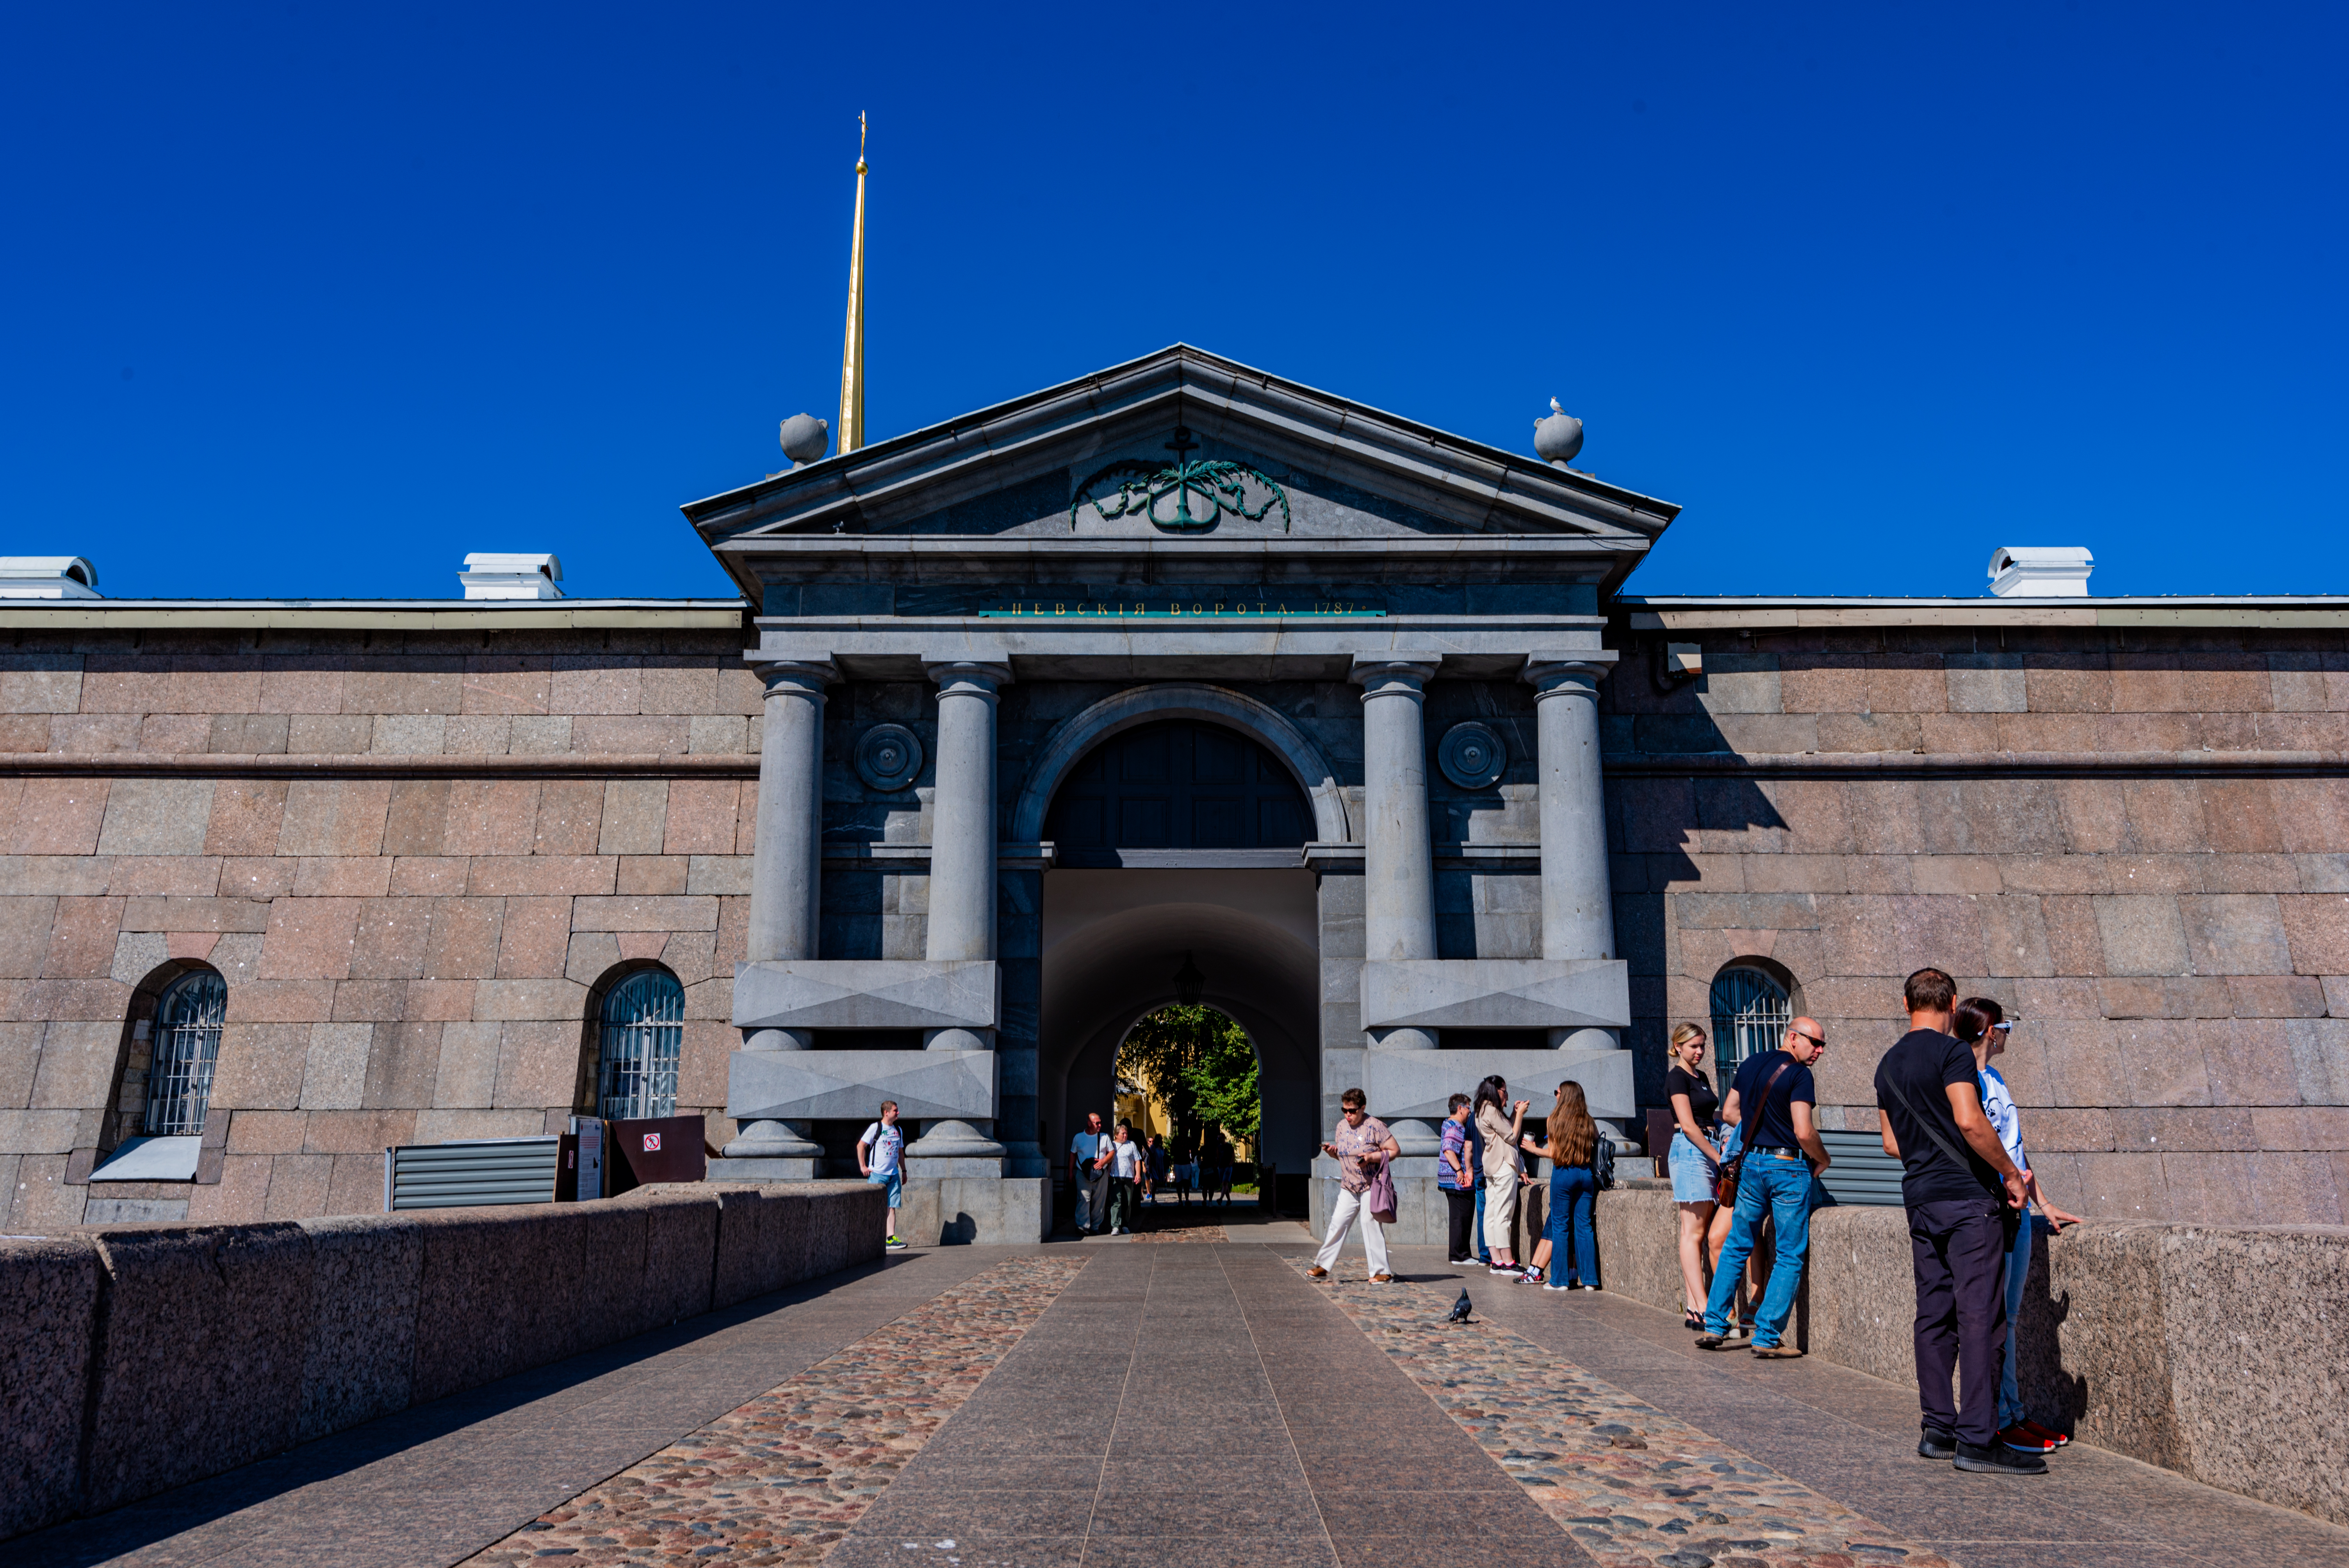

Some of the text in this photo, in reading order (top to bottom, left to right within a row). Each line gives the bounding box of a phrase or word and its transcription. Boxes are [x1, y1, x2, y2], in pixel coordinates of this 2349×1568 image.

[1012, 602, 1354, 615] НЕВСКІЯ ВОРОТА. 1787
